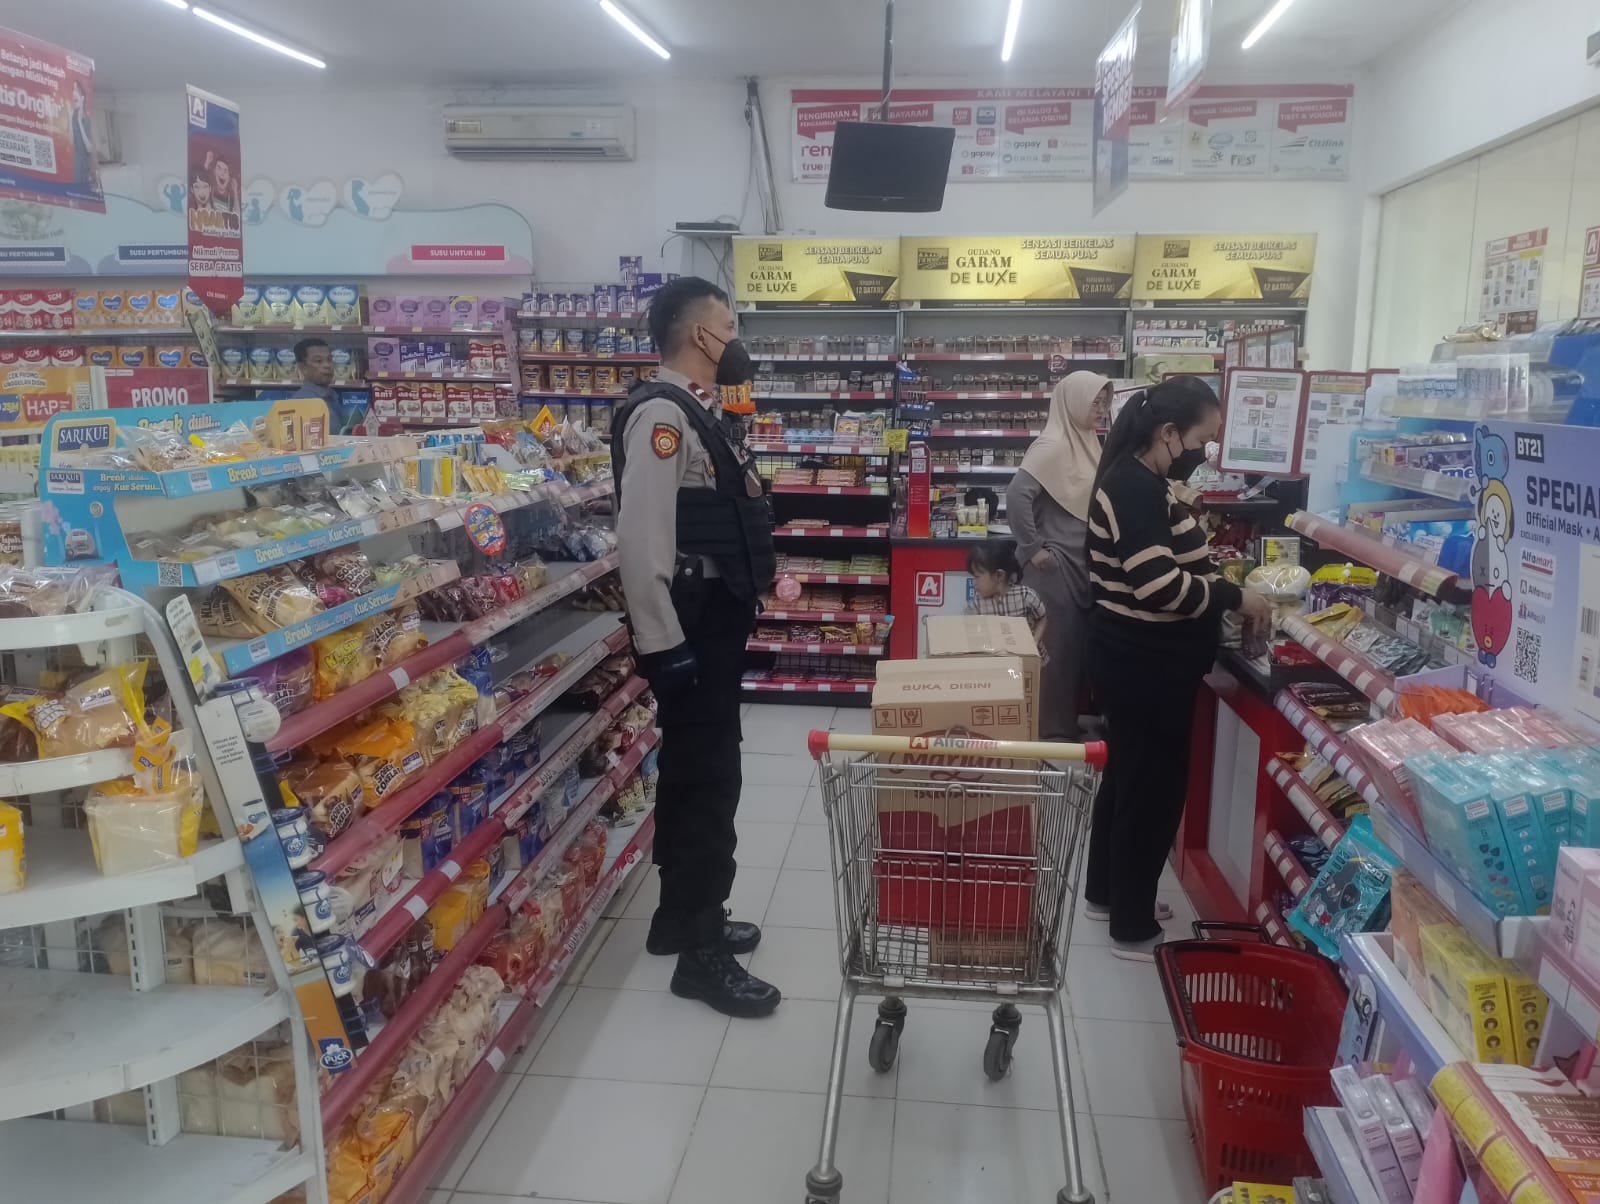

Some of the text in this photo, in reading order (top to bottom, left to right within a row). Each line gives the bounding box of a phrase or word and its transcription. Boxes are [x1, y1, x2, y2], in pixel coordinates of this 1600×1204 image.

[956, 256, 1012, 268] GARAM
[1034, 250, 1098, 260] SEMUA PUAS
[190, 261, 242, 273] SERBA GRATIS
[1152, 268, 1198, 278] GARAM
[750, 271, 793, 281] GARAM
[951, 270, 1017, 287] DE LUXE
[747, 281, 798, 295] DE LUXE
[1147, 278, 1201, 292] DE LUXE
[25, 350, 40, 358] SGM
[58, 349, 74, 357] SGM
[132, 388, 188, 407] PROMO
[60, 425, 108, 444] SARI KUE
[1517, 437, 1543, 458] BT21
[228, 464, 258, 483] Break
[1526, 475, 1600, 520] SPECIA
[1526, 511, 1557, 532] Official
[1558, 517, 1583, 538] Mask
[255, 546, 285, 563] Break
[1522, 550, 1554, 569] Alfamart
[284, 624, 312, 645] Break
[902, 682, 992, 692] BUKA DISINI
[324, 1051, 349, 1064] Puck
